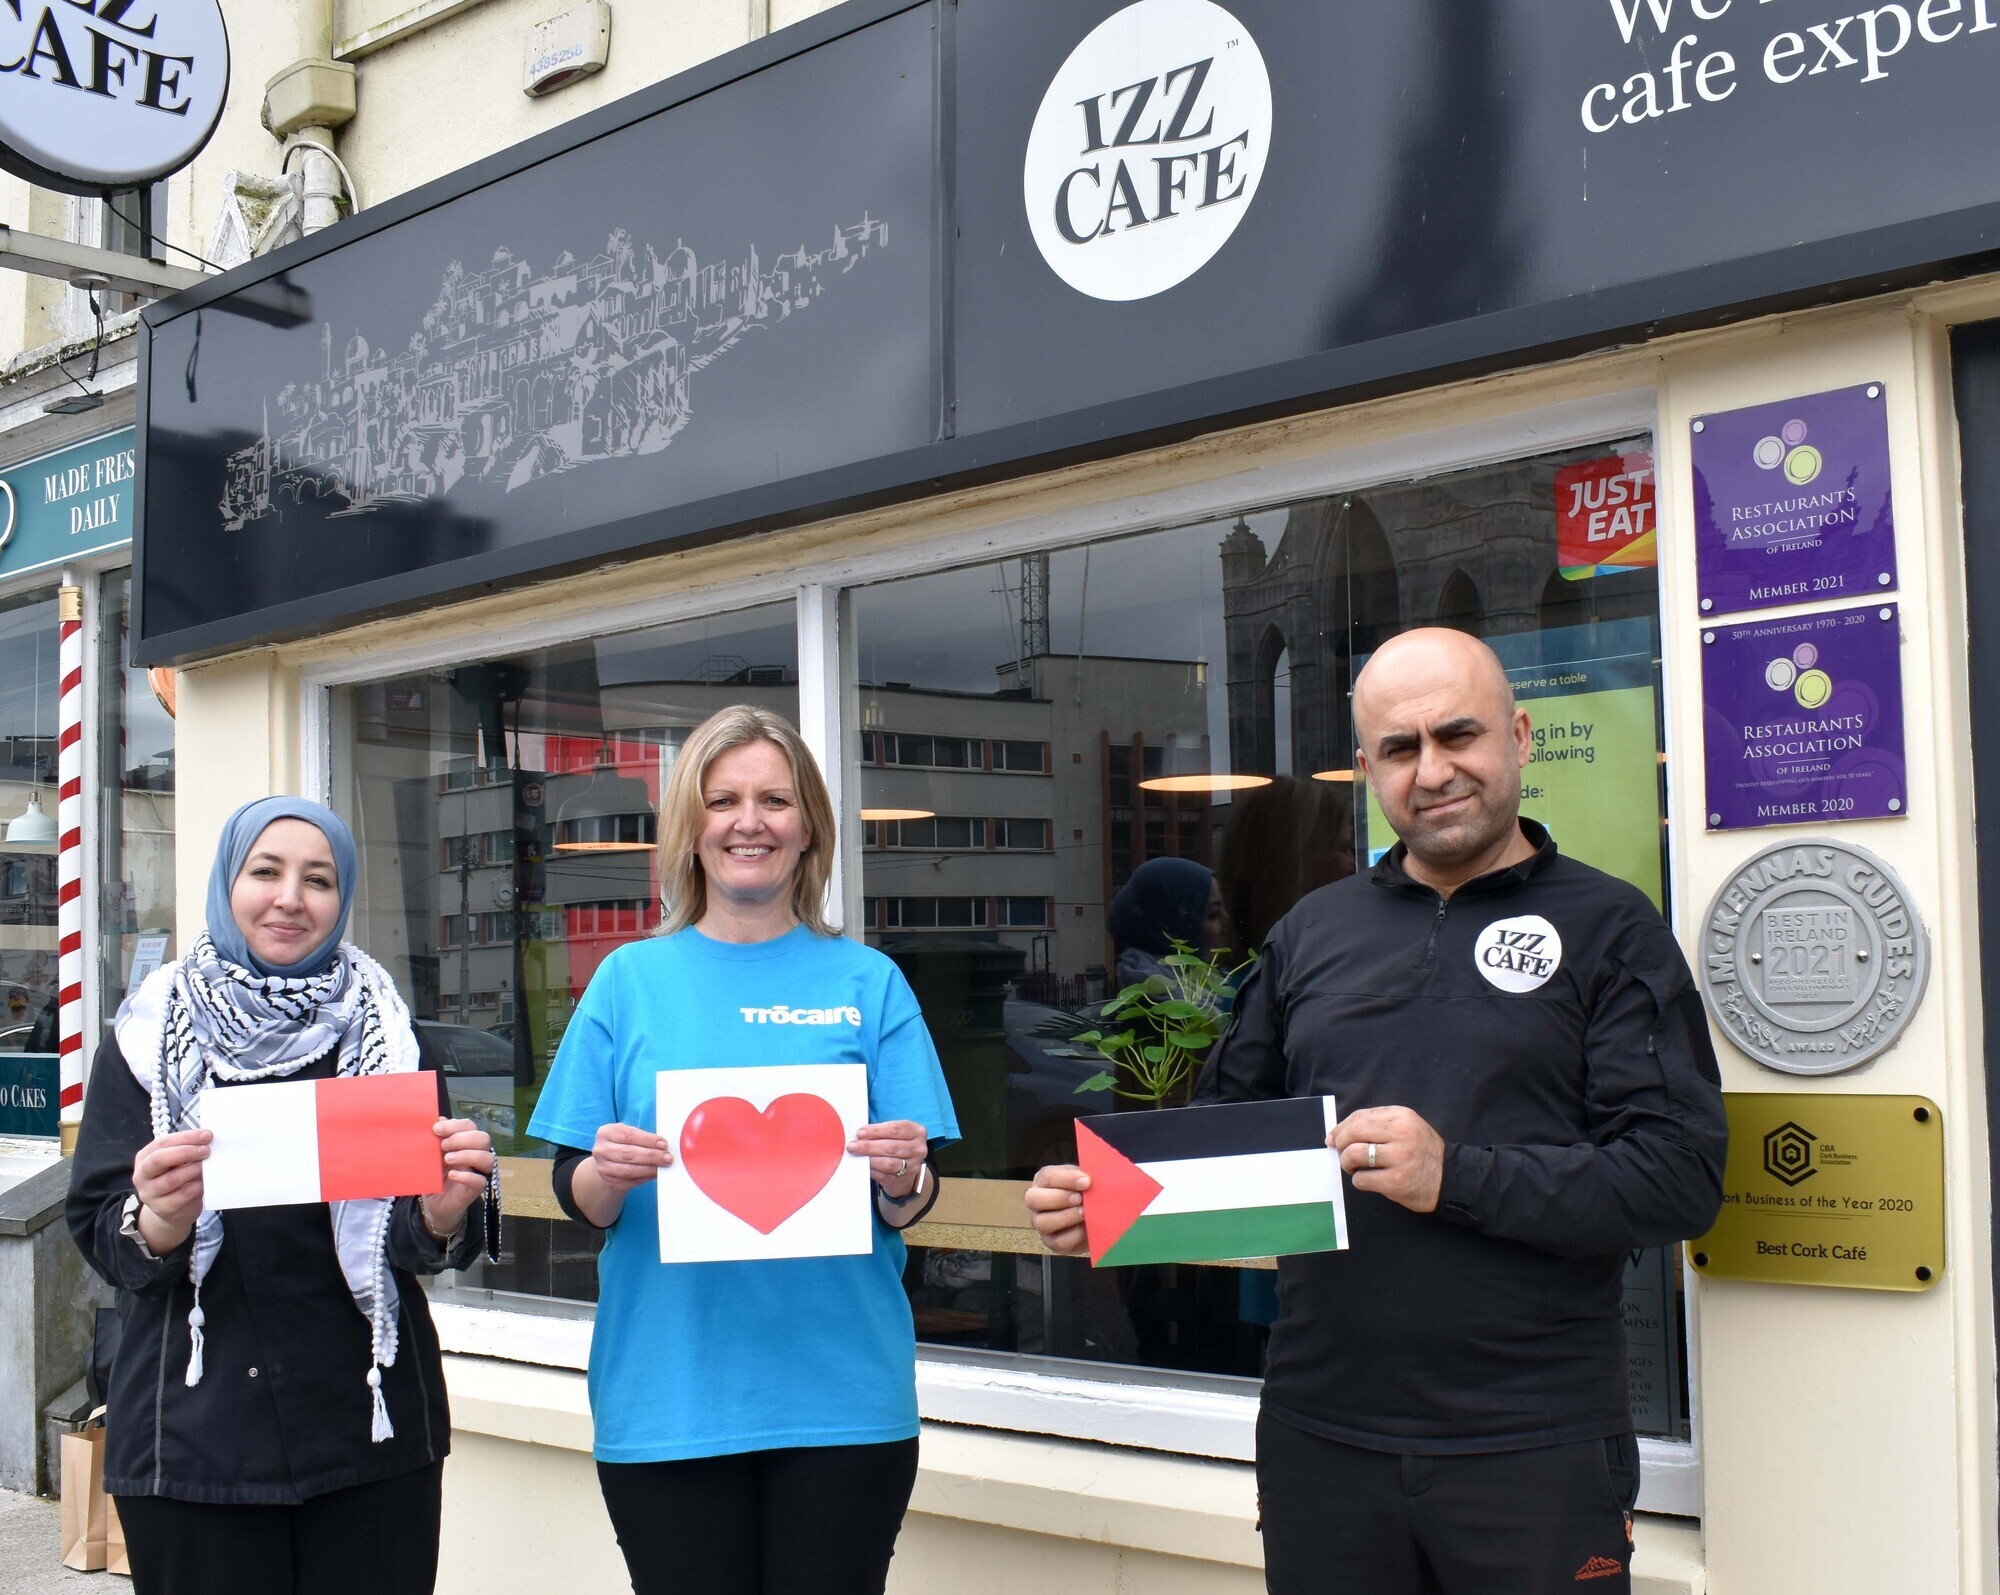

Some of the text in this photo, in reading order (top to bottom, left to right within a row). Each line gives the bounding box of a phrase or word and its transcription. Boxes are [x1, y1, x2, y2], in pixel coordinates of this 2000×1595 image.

[1581, 34, 1737, 133] cafe
[1073, 56, 1214, 156] IZZ
[1053, 129, 1249, 245] CAFE
[44, 449, 135, 504] MADE FRES
[1567, 469, 1650, 518] JUST
[1731, 487, 1855, 521] RESTAURANTS
[70, 493, 120, 534] DAILY
[1587, 502, 1652, 542] EAT
[1731, 508, 1855, 541] ASSOCIATION
[1781, 539, 1822, 553] IRELAND
[1750, 575, 1845, 600] MEMBER 2021
[1753, 622, 1813, 637] ANNIVERSARY
[1816, 618, 1836, 629] 1970
[1844, 614, 1865, 626] 2020
[1509, 672, 1587, 690] eserve a table
[1550, 723, 1566, 739] in
[1571, 721, 1594, 740] by
[1744, 713, 1863, 740] RESTAURANTS
[1528, 745, 1595, 763] ollowing
[1743, 734, 1863, 759] ASSOCIATION
[1791, 763, 1831, 774] IRELAND
[1520, 785, 1544, 799] de:
[1757, 797, 1854, 817] MEMBER 2020
[1768, 912, 1848, 928] BEST IN
[1846, 864, 1915, 979] GUIDES
[1495, 929, 1547, 955] IZZ
[1768, 928, 1848, 944] IRELAND
[1482, 946, 1553, 978] CAFE
[1769, 944, 1847, 979] 2021
[1787, 1042, 1835, 1053] AWARD
[1819, 1144, 1835, 1152] CBA
[1723, 1192, 1913, 1211] ork Business of the Year 2020
[1756, 1240, 1867, 1260] Best Cork Café
[1623, 1318, 1658, 1328] MISES
